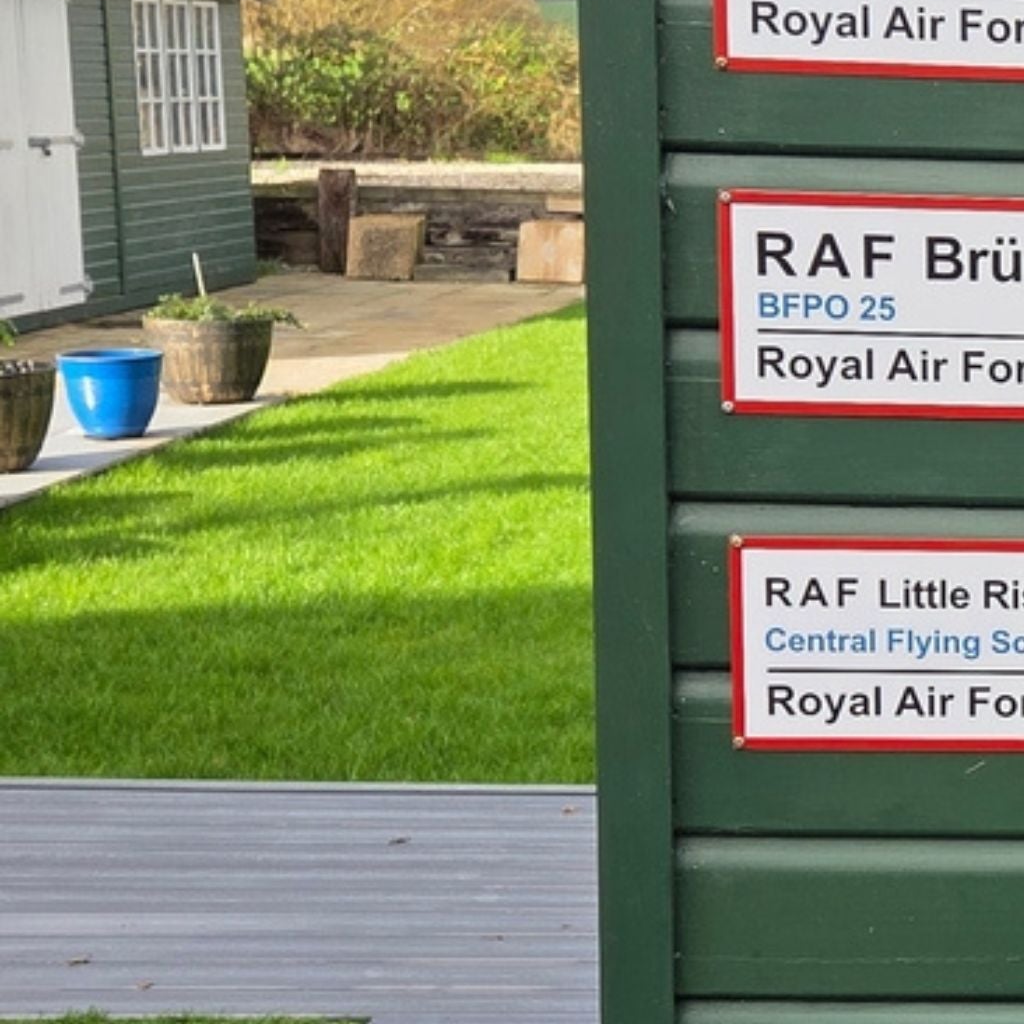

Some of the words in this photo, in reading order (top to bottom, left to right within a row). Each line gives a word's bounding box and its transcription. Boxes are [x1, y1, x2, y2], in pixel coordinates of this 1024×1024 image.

[751, 0, 870, 46] Royal
[883, 5, 946, 41] Air
[756, 230, 896, 280] RAF
[758, 292, 850, 320] BFPO
[859, 294, 896, 322] 25
[757, 345, 874, 389] Royal
[886, 348, 949, 383] Air
[765, 576, 859, 609] RAF
[879, 578, 971, 610] Little
[765, 627, 876, 654] Central
[887, 628, 981, 660] Flying
[767, 684, 882, 725] Royal
[894, 685, 955, 718] Air
